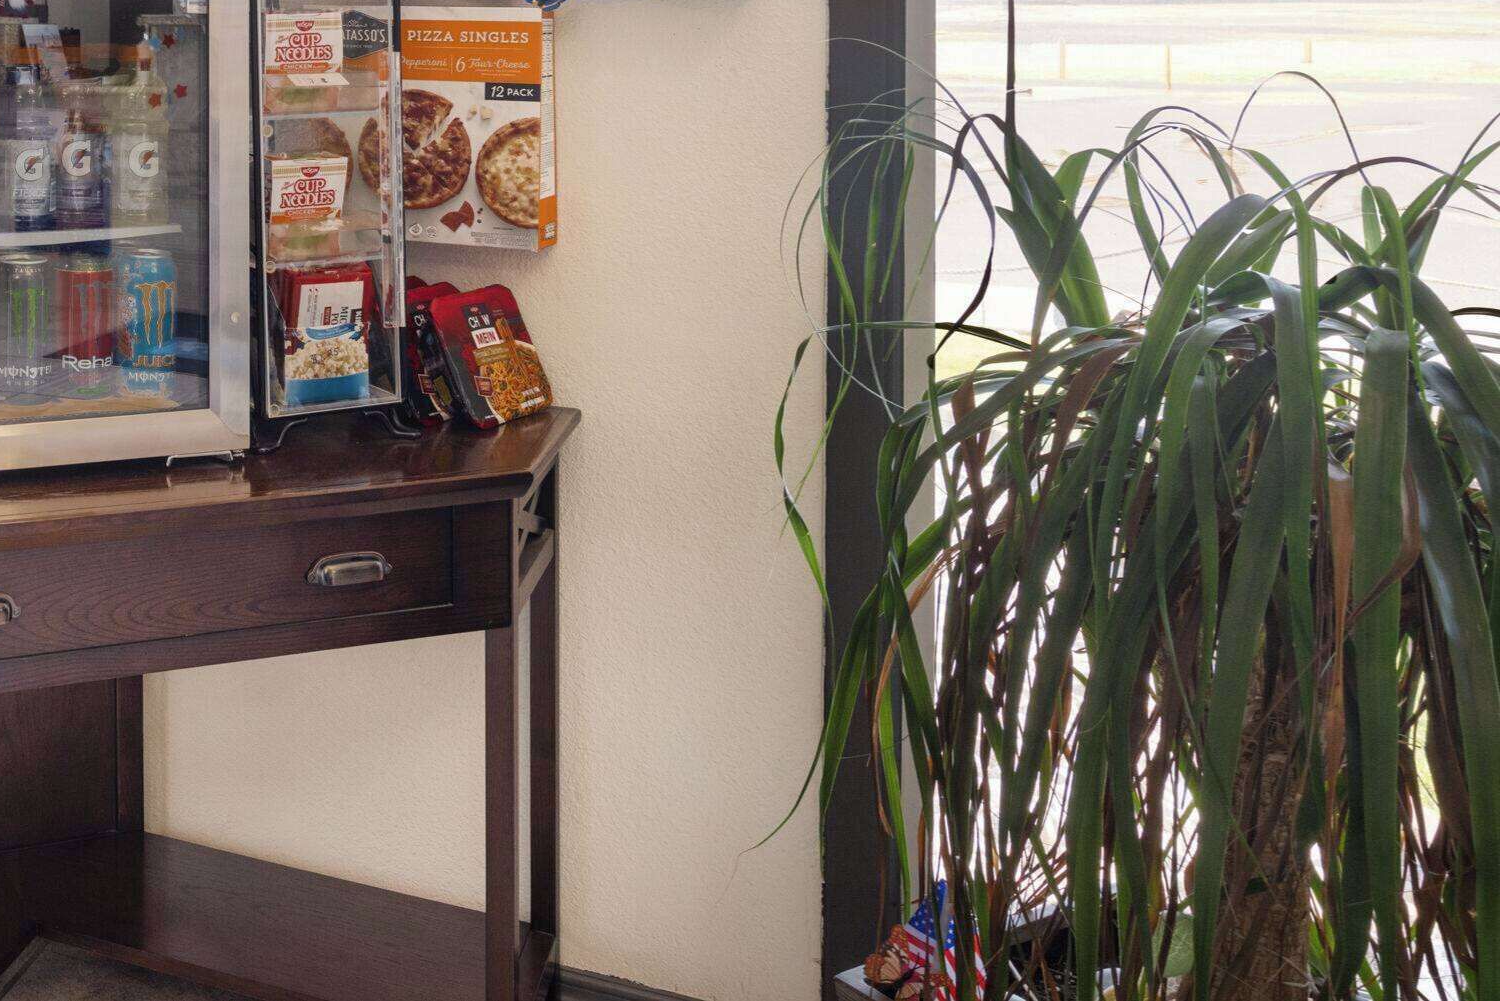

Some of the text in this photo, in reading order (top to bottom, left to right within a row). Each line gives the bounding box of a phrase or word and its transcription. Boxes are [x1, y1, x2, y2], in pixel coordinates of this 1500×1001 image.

[289, 33, 321, 48] CUP
[407, 30, 529, 44] PIZZA SINGLES
[275, 45, 333, 62] NOODLES
[455, 55, 466, 73] 6
[490, 85, 534, 98] 12 PACK
[294, 178, 326, 193] CUP
[280, 190, 335, 208] NOODLES
[467, 314, 490, 328] CHW
[476, 331, 497, 344] MEIN
